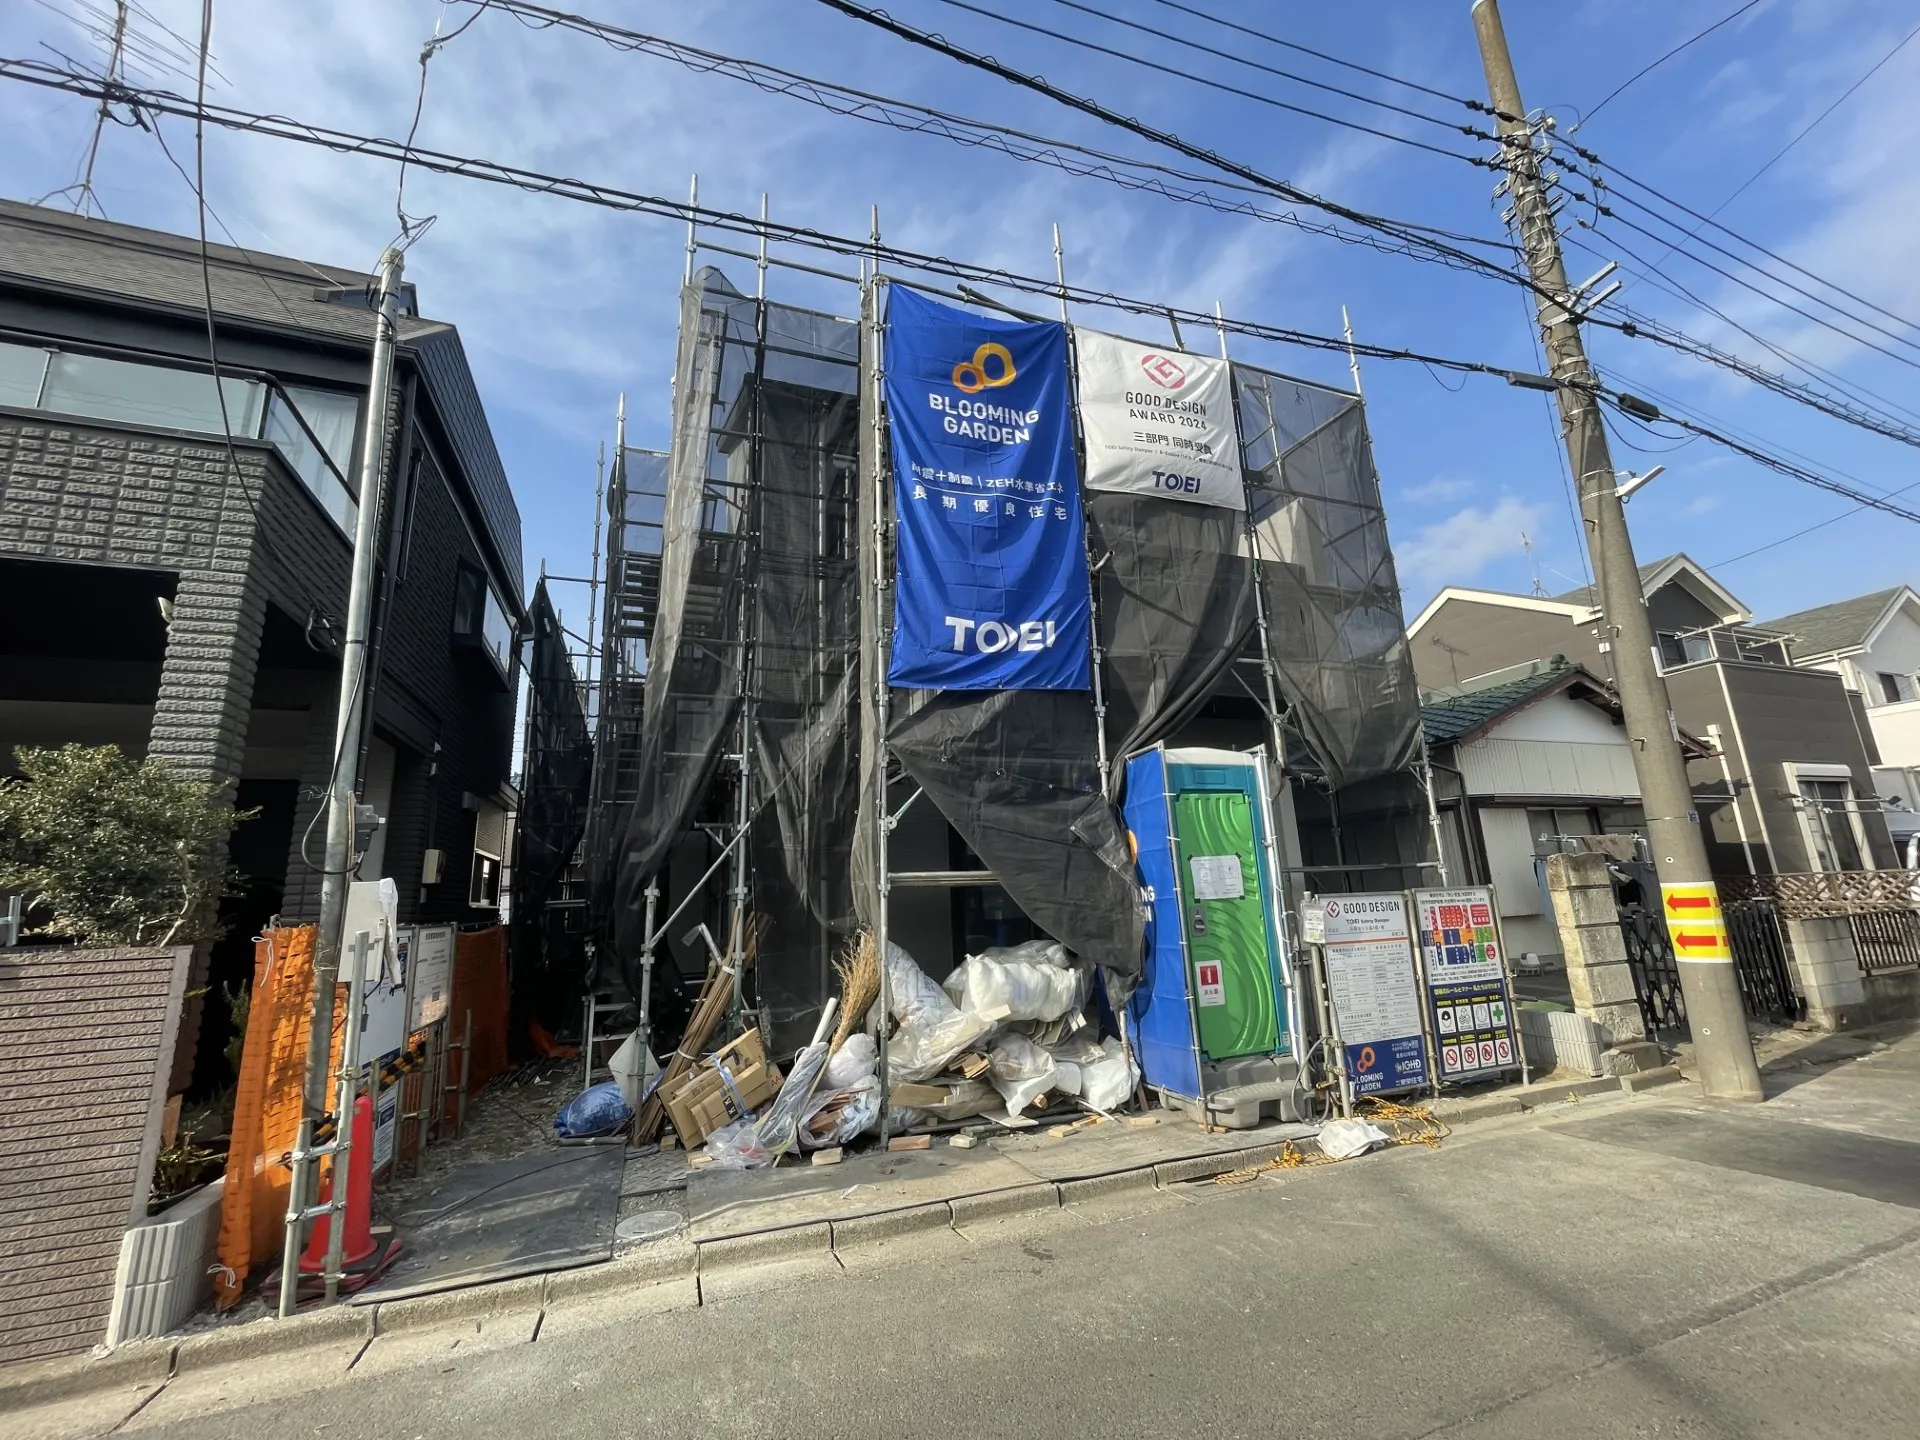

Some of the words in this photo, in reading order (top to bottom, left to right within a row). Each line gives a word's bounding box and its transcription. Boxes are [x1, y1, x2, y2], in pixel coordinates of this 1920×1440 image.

[928, 392, 1040, 427] BLOOMING
[1125, 391, 1161, 407] GOOD
[1164, 397, 1207, 417] DESIGN
[943, 416, 1030, 445] GARDEN
[1129, 408, 1176, 424] AWARD
[1178, 415, 1208, 431] 2024
[1133, 431, 1170, 446] 三部門
[1152, 470, 1202, 494] TOEI
[912, 485, 1068, 521] 長期優良住宅
[944, 615, 1057, 654] TOEI
[1343, 902, 1367, 914] GOOD
[1369, 900, 1400, 912] DESIGN
[1355, 1072, 1384, 1084] LOOMING
